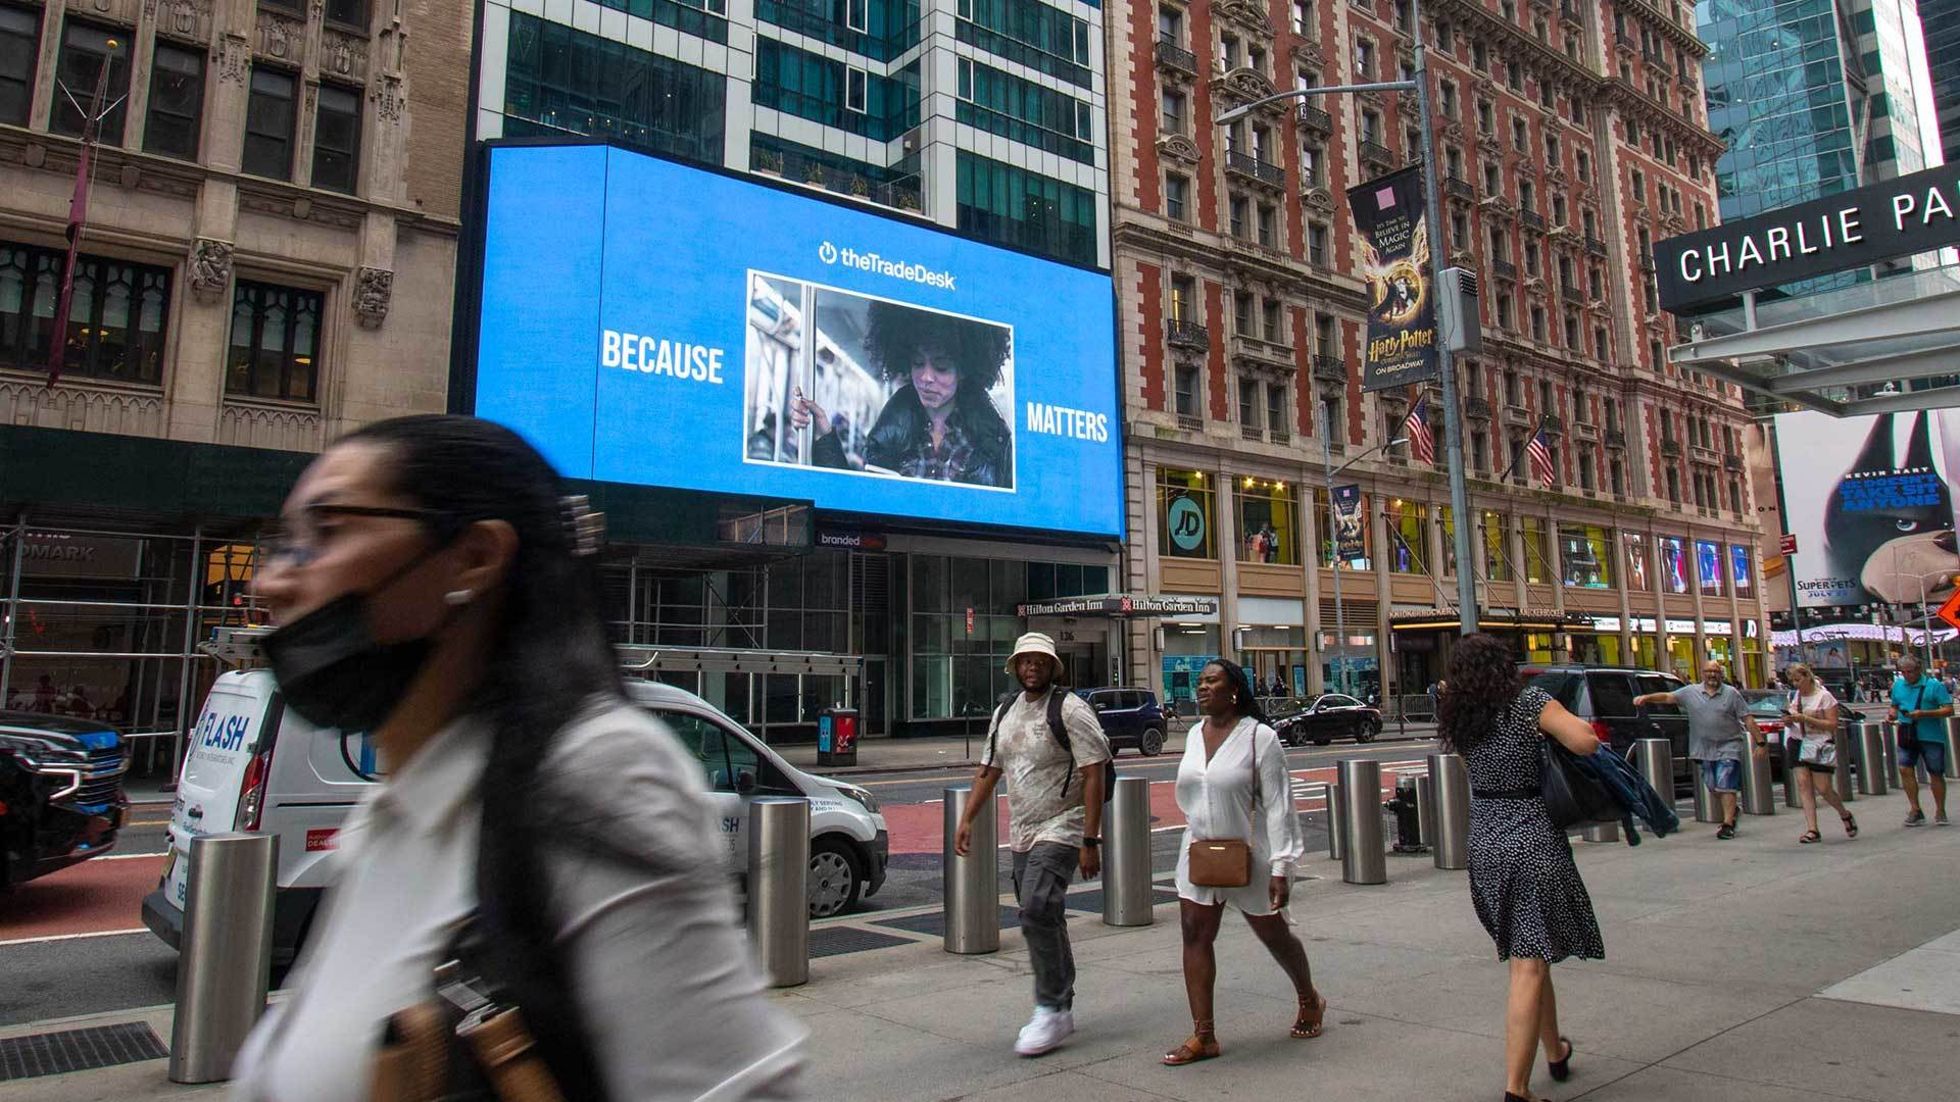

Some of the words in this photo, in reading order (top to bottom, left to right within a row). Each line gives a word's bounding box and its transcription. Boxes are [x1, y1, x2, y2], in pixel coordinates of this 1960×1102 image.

[1379, 229, 1410, 248] MAGIC
[1680, 206, 1863, 283] CHARLIE
[1892, 180, 1960, 231] PA
[1385, 241, 1406, 255] AGAIN
[841, 247, 956, 291] theTradeDesk
[1368, 336, 1400, 362] Harry
[1400, 329, 1433, 358] Potter
[602, 329, 724, 384] BECAUSE
[1375, 366, 1387, 376] ON
[1387, 359, 1424, 373] BROADWAY
[1027, 401, 1108, 443] MATTERS
[1845, 470, 1886, 480] KEVIN
[1893, 466, 1930, 475] HART
[1841, 486, 1894, 501] TAKE
[1842, 494, 1940, 512] ANYONE
[1174, 510, 1201, 537] JD
[821, 534, 860, 546] branded
[14, 543, 95, 562] DMARK
[1026, 604, 1054, 616] Hilton
[1054, 601, 1085, 613] Garden
[1086, 599, 1103, 610] Inn
[1132, 599, 1162, 611] Hilton
[1162, 599, 1194, 612] Garden
[1195, 602, 1211, 613] Inn
[1810, 631, 1849, 643] OFT
[200, 712, 250, 752] FLASH
